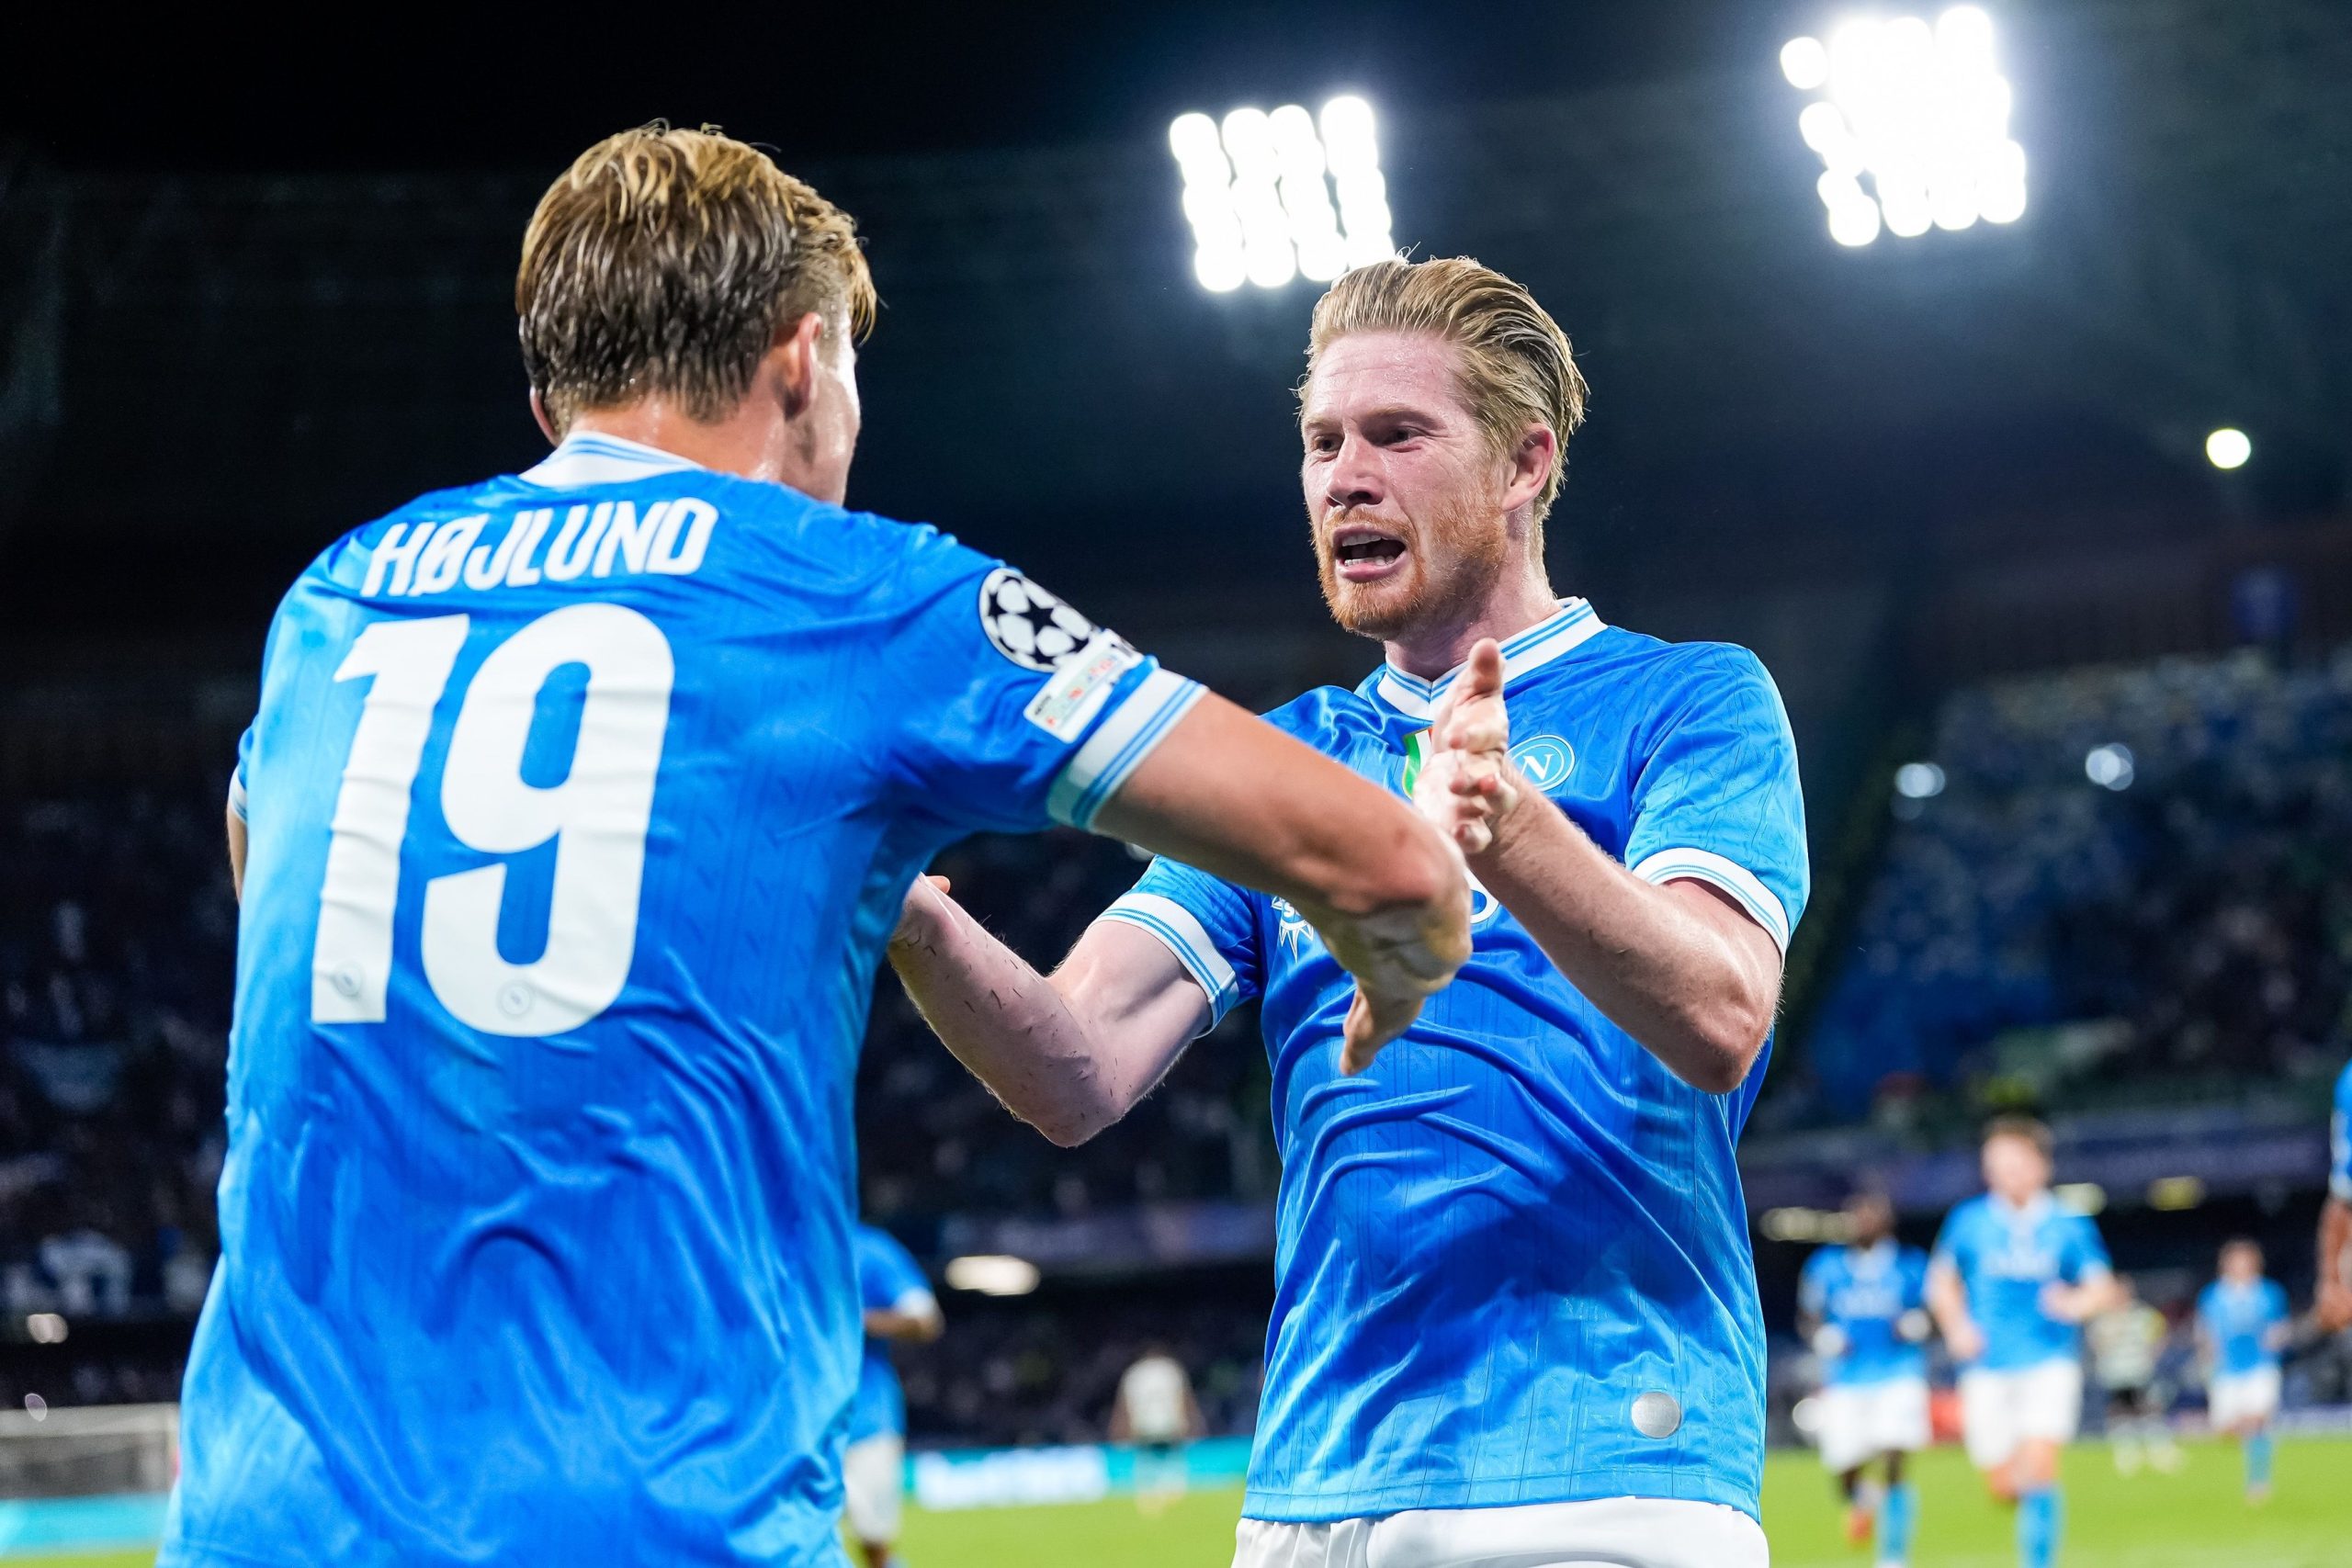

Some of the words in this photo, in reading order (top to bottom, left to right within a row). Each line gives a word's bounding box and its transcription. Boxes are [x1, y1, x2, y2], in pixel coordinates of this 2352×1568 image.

[361, 497, 719, 597] HØJLUND
[1521, 753, 1555, 781] N
[311, 603, 675, 1037] 19
